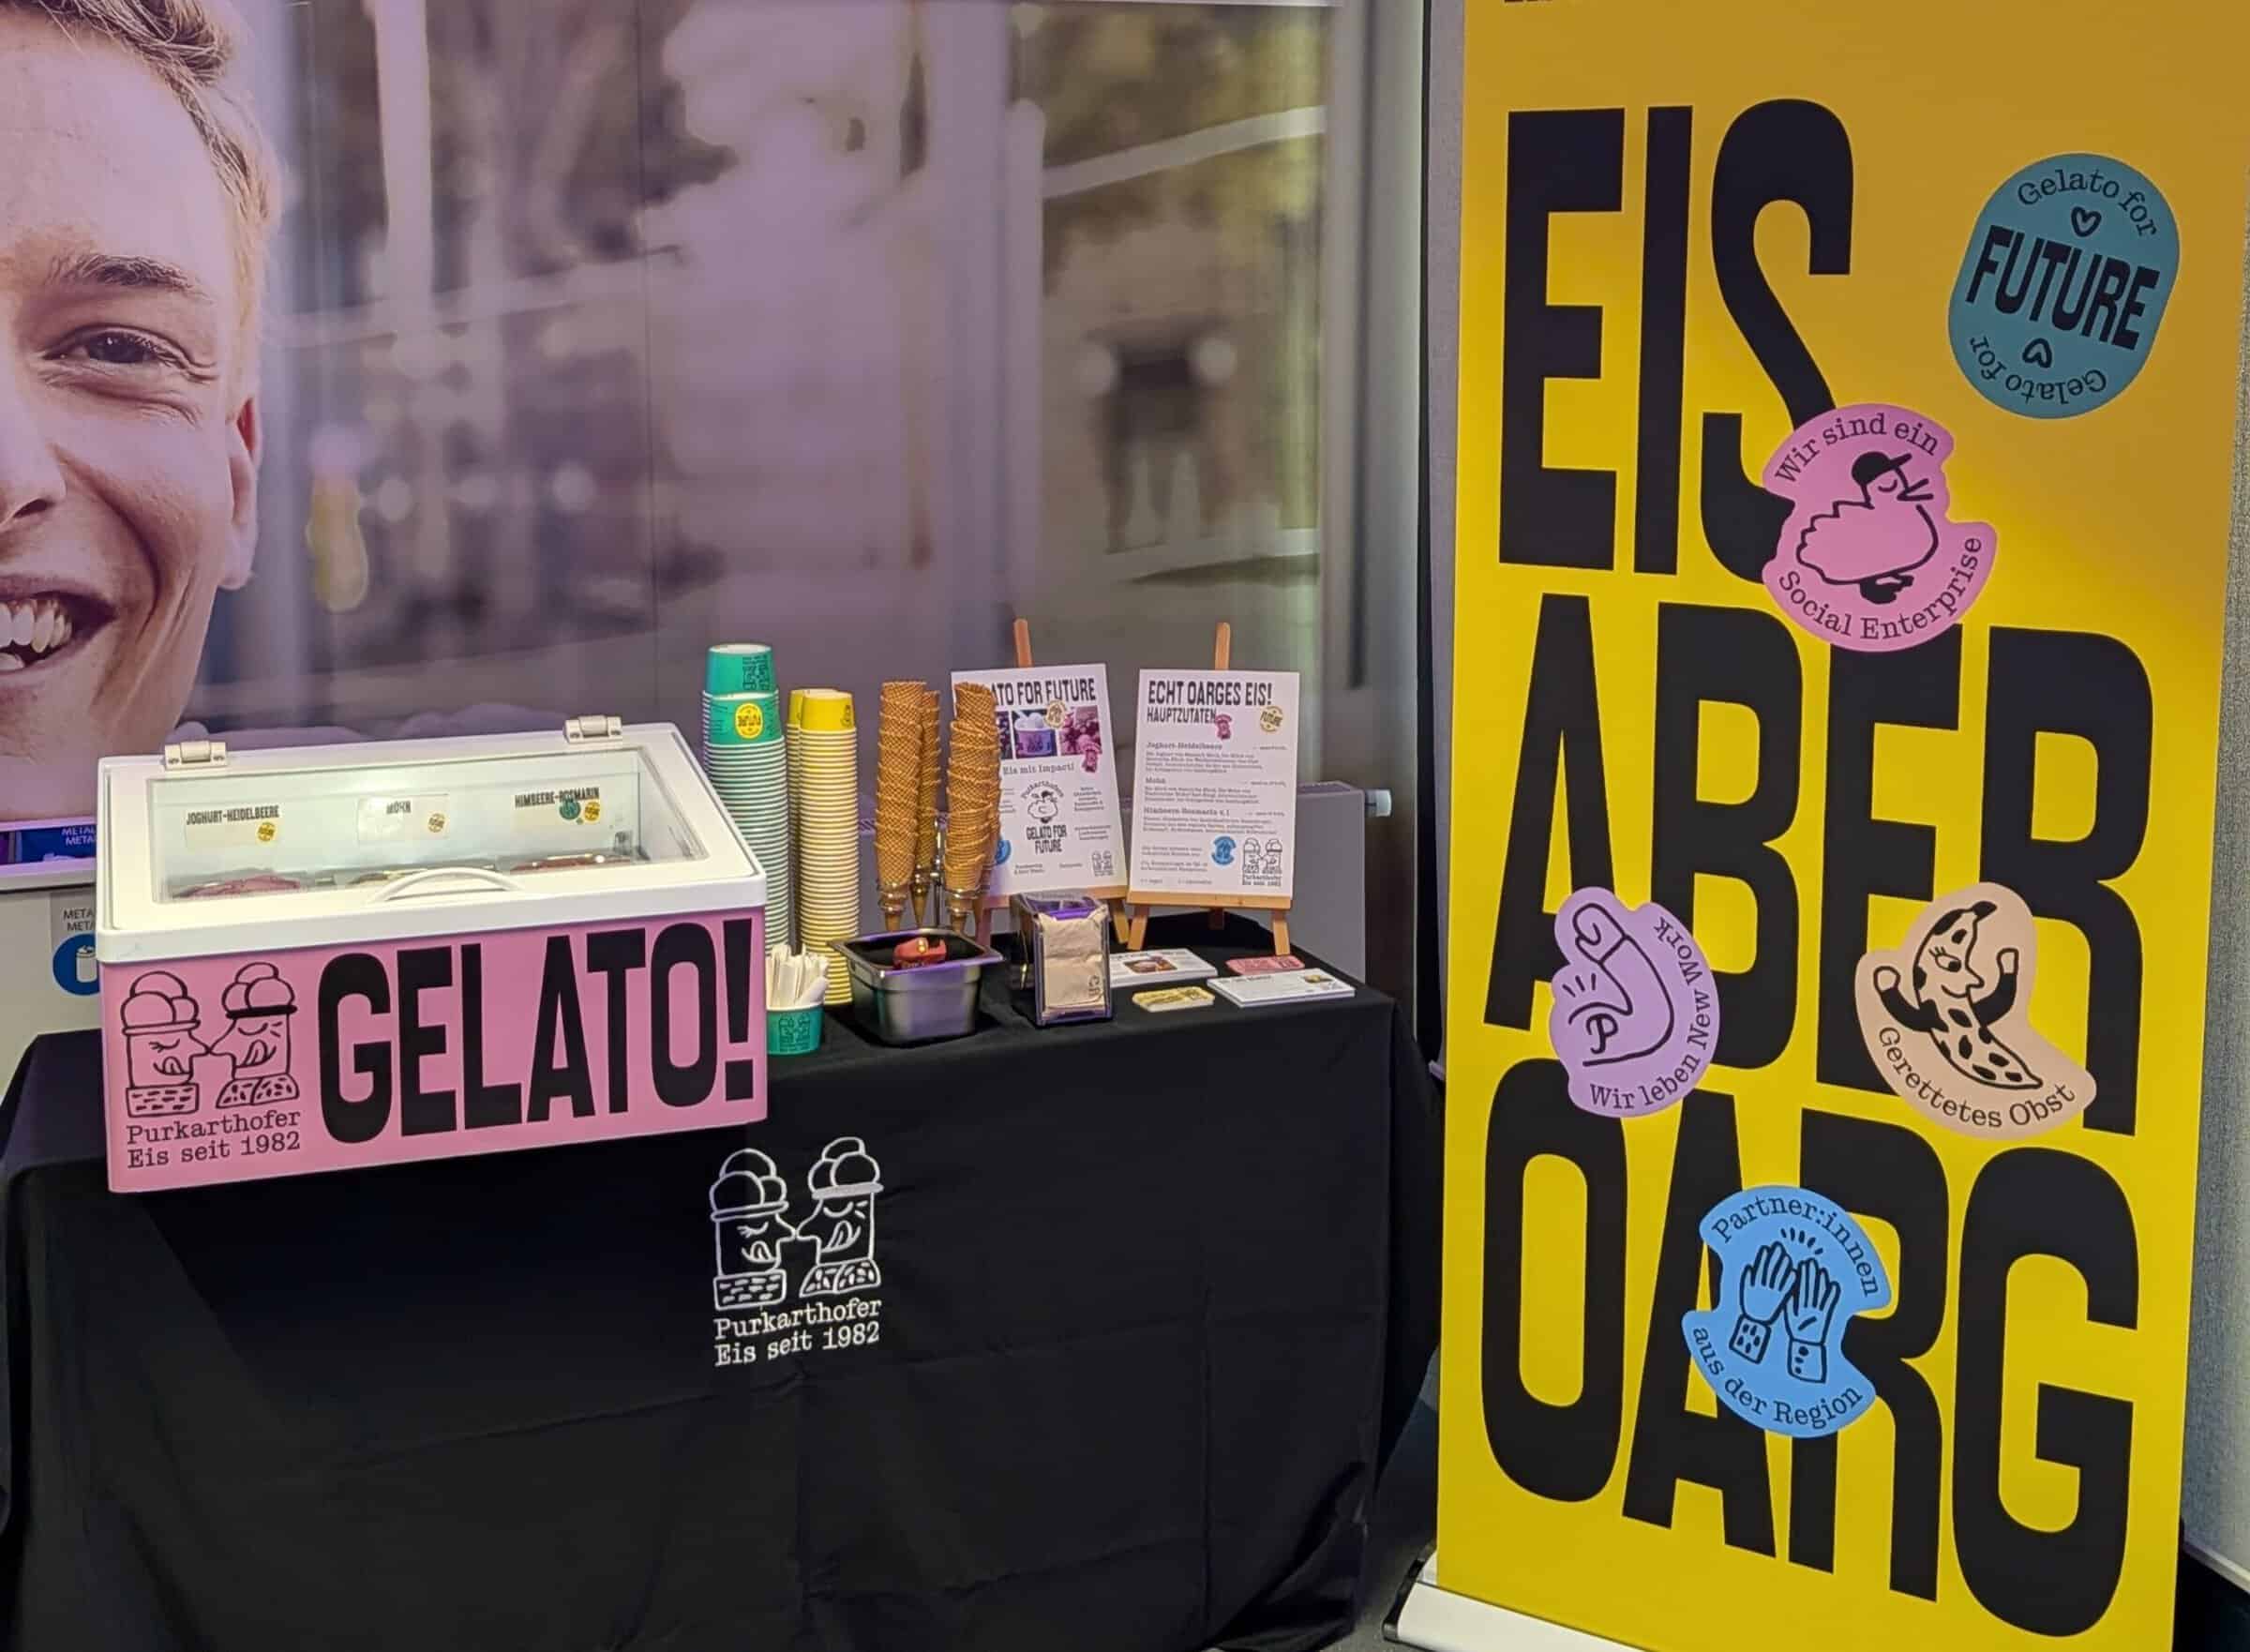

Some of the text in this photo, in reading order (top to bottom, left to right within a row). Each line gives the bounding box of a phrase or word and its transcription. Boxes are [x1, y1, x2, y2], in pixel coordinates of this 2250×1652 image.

[2018, 169, 2157, 236] Gelato for
[1965, 224, 2160, 351] FUTURE
[1500, 98, 1854, 585] EIS
[1970, 336, 2108, 404] Gelato for
[1775, 413, 1940, 483] Wir sind ein
[1778, 537, 1982, 639] Social Enterprise
[1017, 680, 1043, 705] FOR
[1045, 677, 1097, 703] FUTURE
[1148, 680, 1272, 706] ECHT OARGES EIS!
[1148, 707, 1217, 724] HAUPTZUTATEN
[187, 804, 279, 826] JOGHURT-HEIDELBEERE
[1484, 592, 2153, 1138] ABER
[318, 917, 754, 1144] GELATO!
[1590, 916, 1711, 1109] Wir leben New Work
[1879, 1027, 2076, 1127] Gerettetes Obst
[127, 1110, 301, 1145] Purkarthofer
[128, 1131, 301, 1169] Eis seit 1982
[1712, 1195, 1880, 1298] Partner:innen
[713, 1298, 883, 1341] Purkarthofer
[713, 1321, 880, 1367] Eis seit 1982
[1480, 1058, 2139, 1637] OARG
[1693, 1327, 1864, 1430] aus der Region
